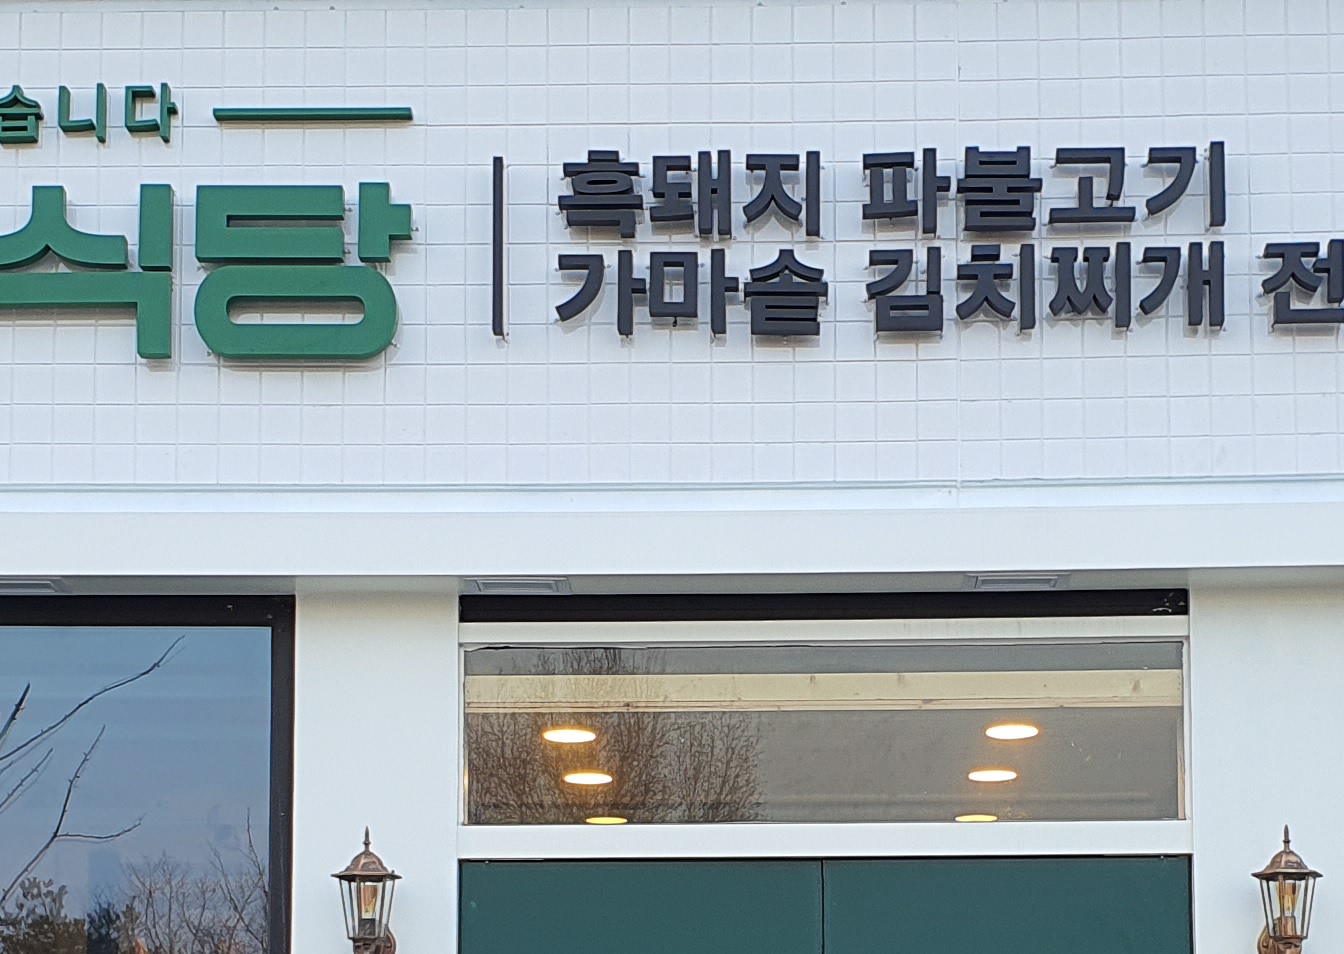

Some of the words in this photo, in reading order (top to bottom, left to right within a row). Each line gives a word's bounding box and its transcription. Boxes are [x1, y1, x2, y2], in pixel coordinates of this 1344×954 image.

[556, 149, 824, 239] 흑돼지
[859, 140, 1226, 240] 파불고기
[555, 248, 829, 337] 가마솥
[863, 240, 1226, 336] 김치찌개
